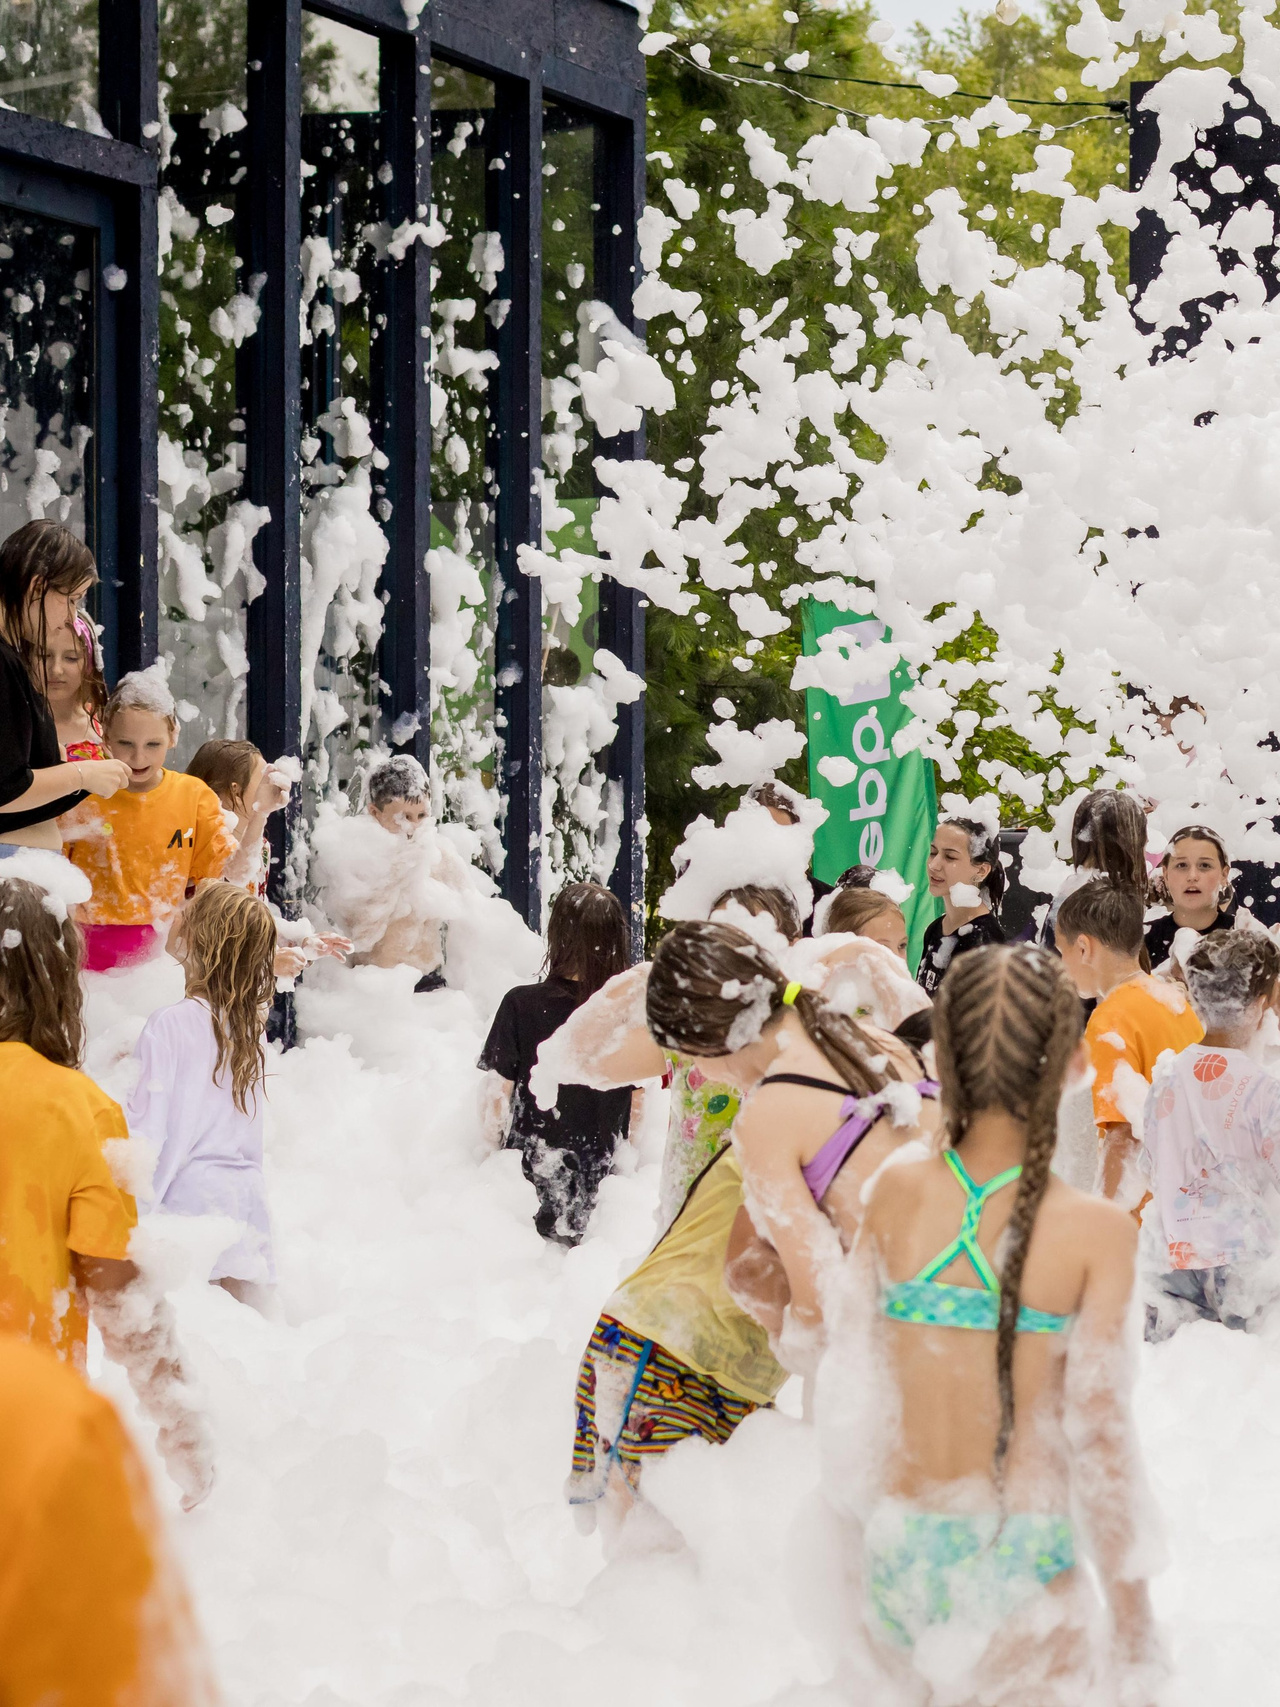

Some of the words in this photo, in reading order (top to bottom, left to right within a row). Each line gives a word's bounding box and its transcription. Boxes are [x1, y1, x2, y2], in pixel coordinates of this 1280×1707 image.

[850, 714, 891, 867] ерь
[1224, 1097, 1238, 1130] REALLY
[1235, 1074, 1253, 1096] COOL
